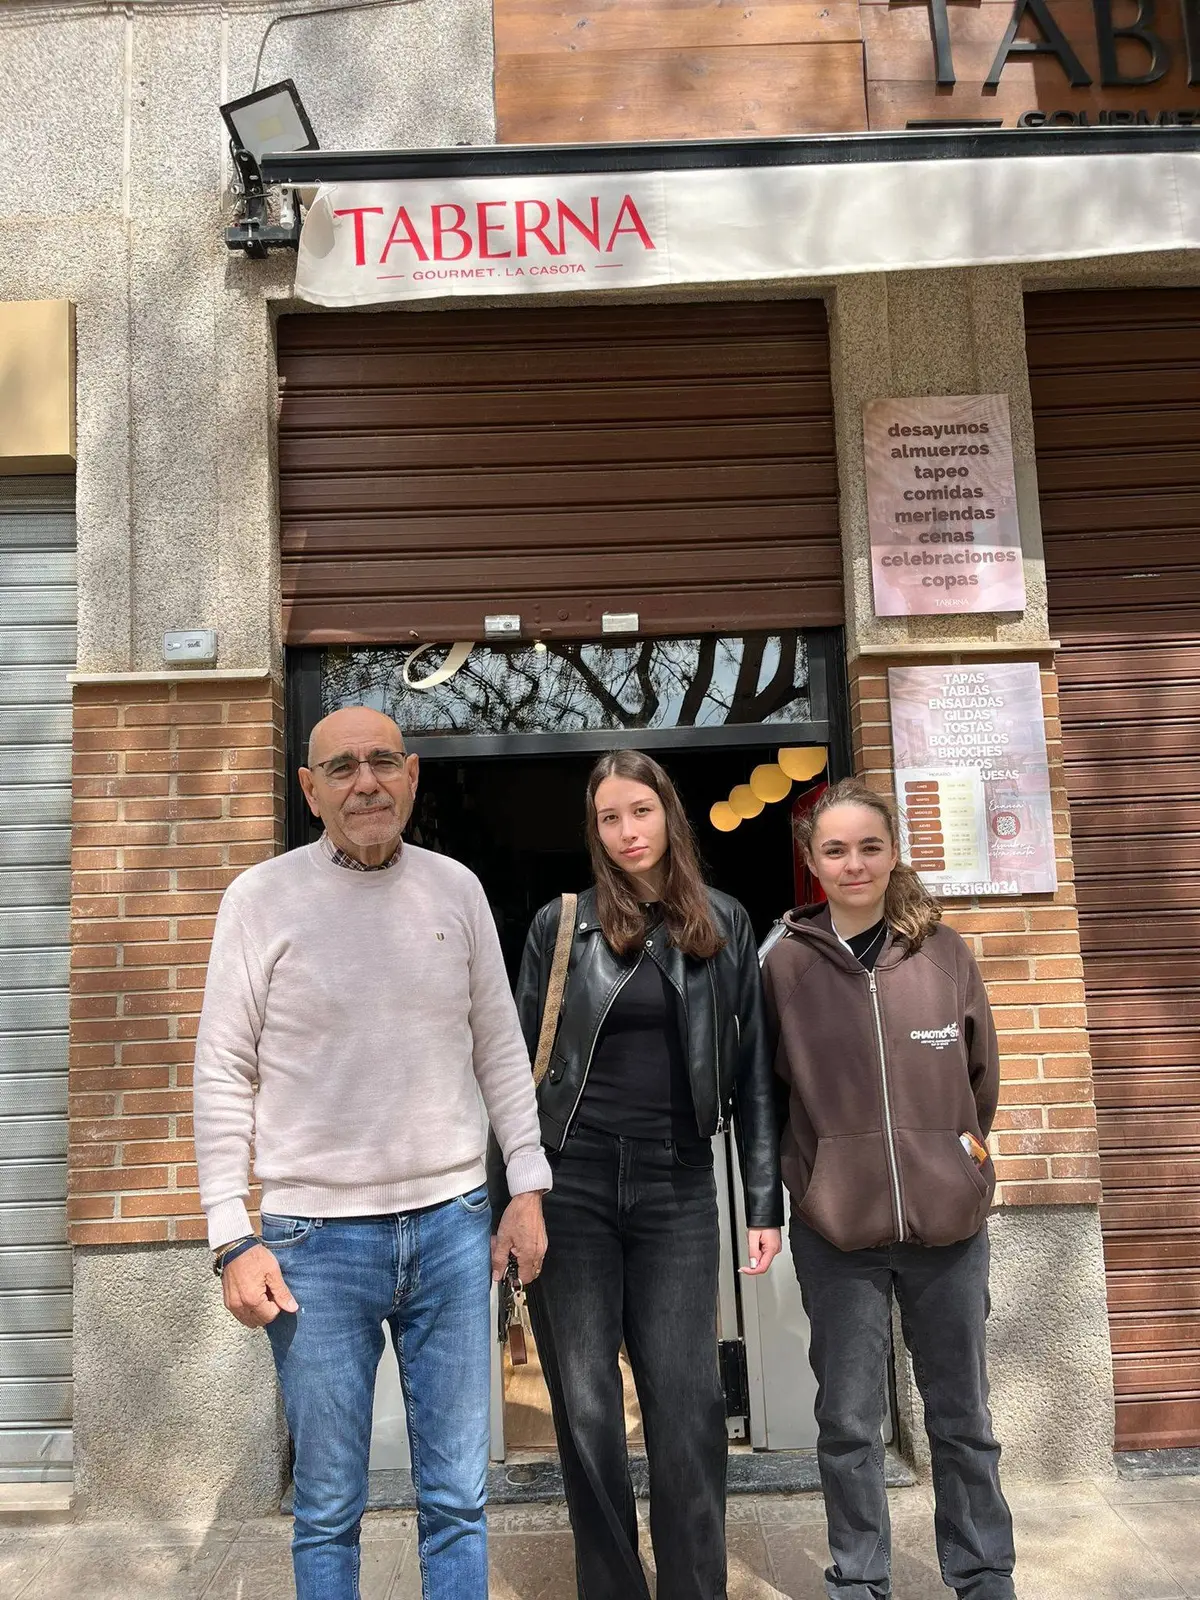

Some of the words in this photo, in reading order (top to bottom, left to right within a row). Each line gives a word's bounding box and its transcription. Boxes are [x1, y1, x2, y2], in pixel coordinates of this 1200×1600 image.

[889, 0, 1200, 87] TAB
[334, 194, 656, 266] TABERNA
[505, 267, 525, 277] LA
[529, 264, 586, 276] CASOTA
[888, 422, 990, 439] desayunos
[891, 444, 990, 459] almuerzos
[914, 465, 969, 482] tapeo
[903, 485, 984, 501] comidas
[894, 506, 996, 524] meriendas
[918, 530, 975, 544] cenas
[881, 550, 1016, 567] celebraciones
[921, 574, 979, 590] copas
[943, 673, 985, 684] TAPAS
[940, 685, 990, 696] TABLAS
[928, 697, 1004, 710] ENSALADAS
[944, 709, 990, 721] GILDAS
[943, 721, 993, 733] TOSTAS
[929, 733, 1009, 746] BOCADILLOS
[937, 745, 1002, 759] BRIOCHES
[951, 758, 993, 769] TACOS
[942, 881, 1018, 896] 653160034
